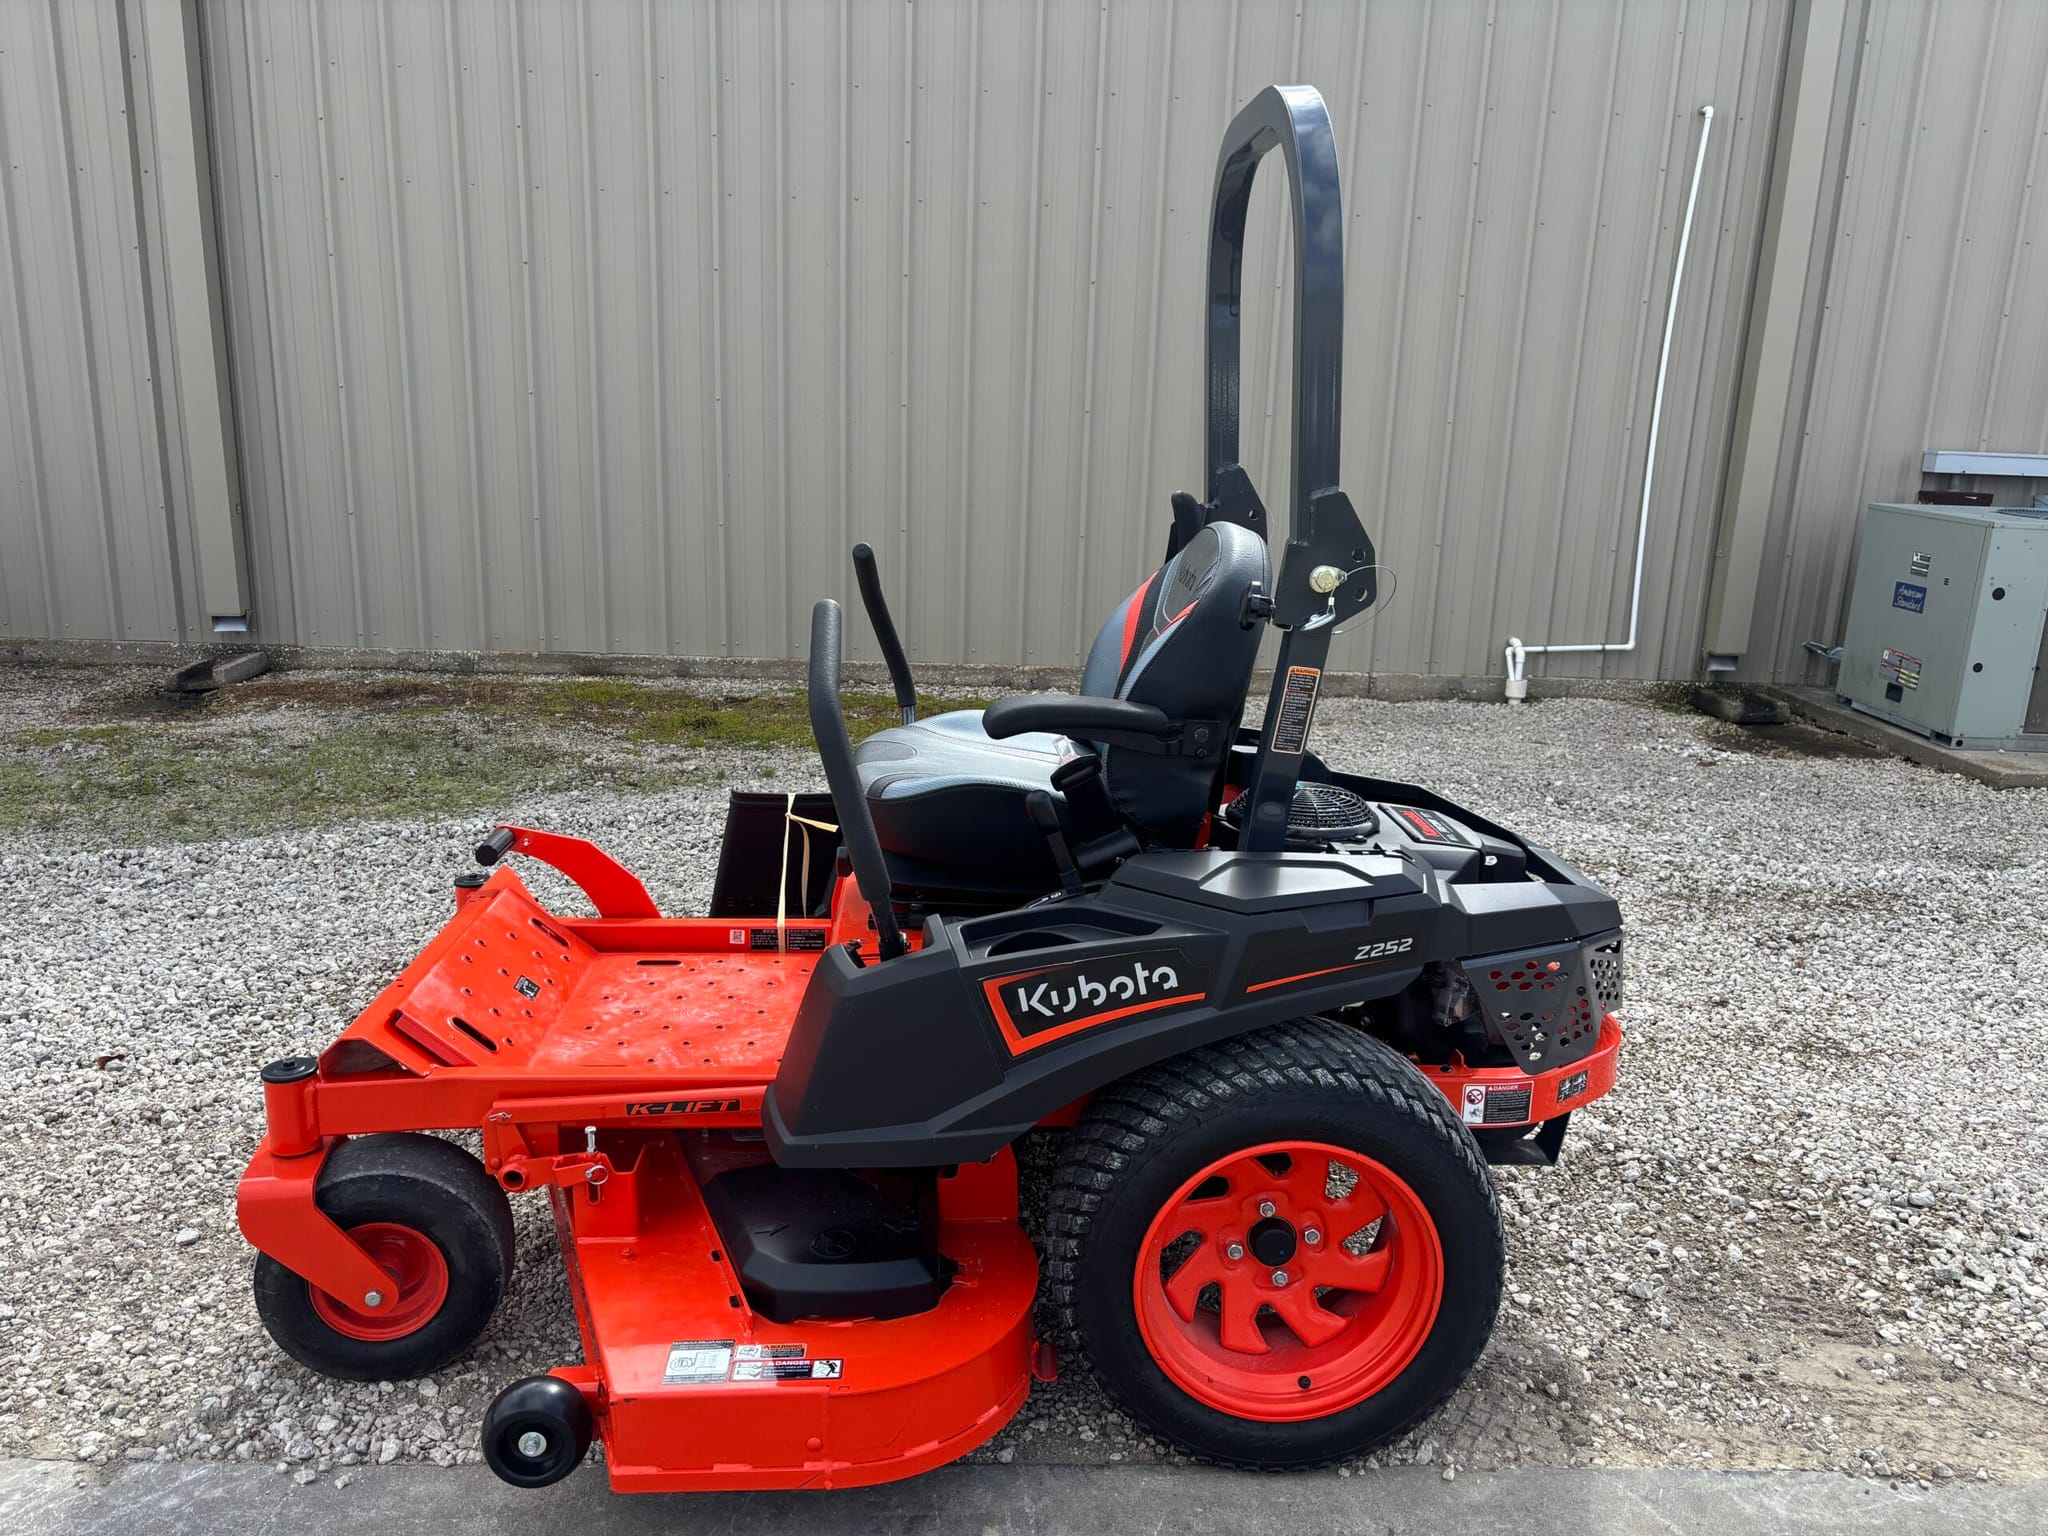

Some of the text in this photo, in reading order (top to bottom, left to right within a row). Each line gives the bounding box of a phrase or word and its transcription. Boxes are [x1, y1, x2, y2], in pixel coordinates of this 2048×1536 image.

[1354, 937, 1413, 960] Z252
[1017, 962, 1179, 1017] Kubota
[630, 1099, 737, 1115] K-LIFT
